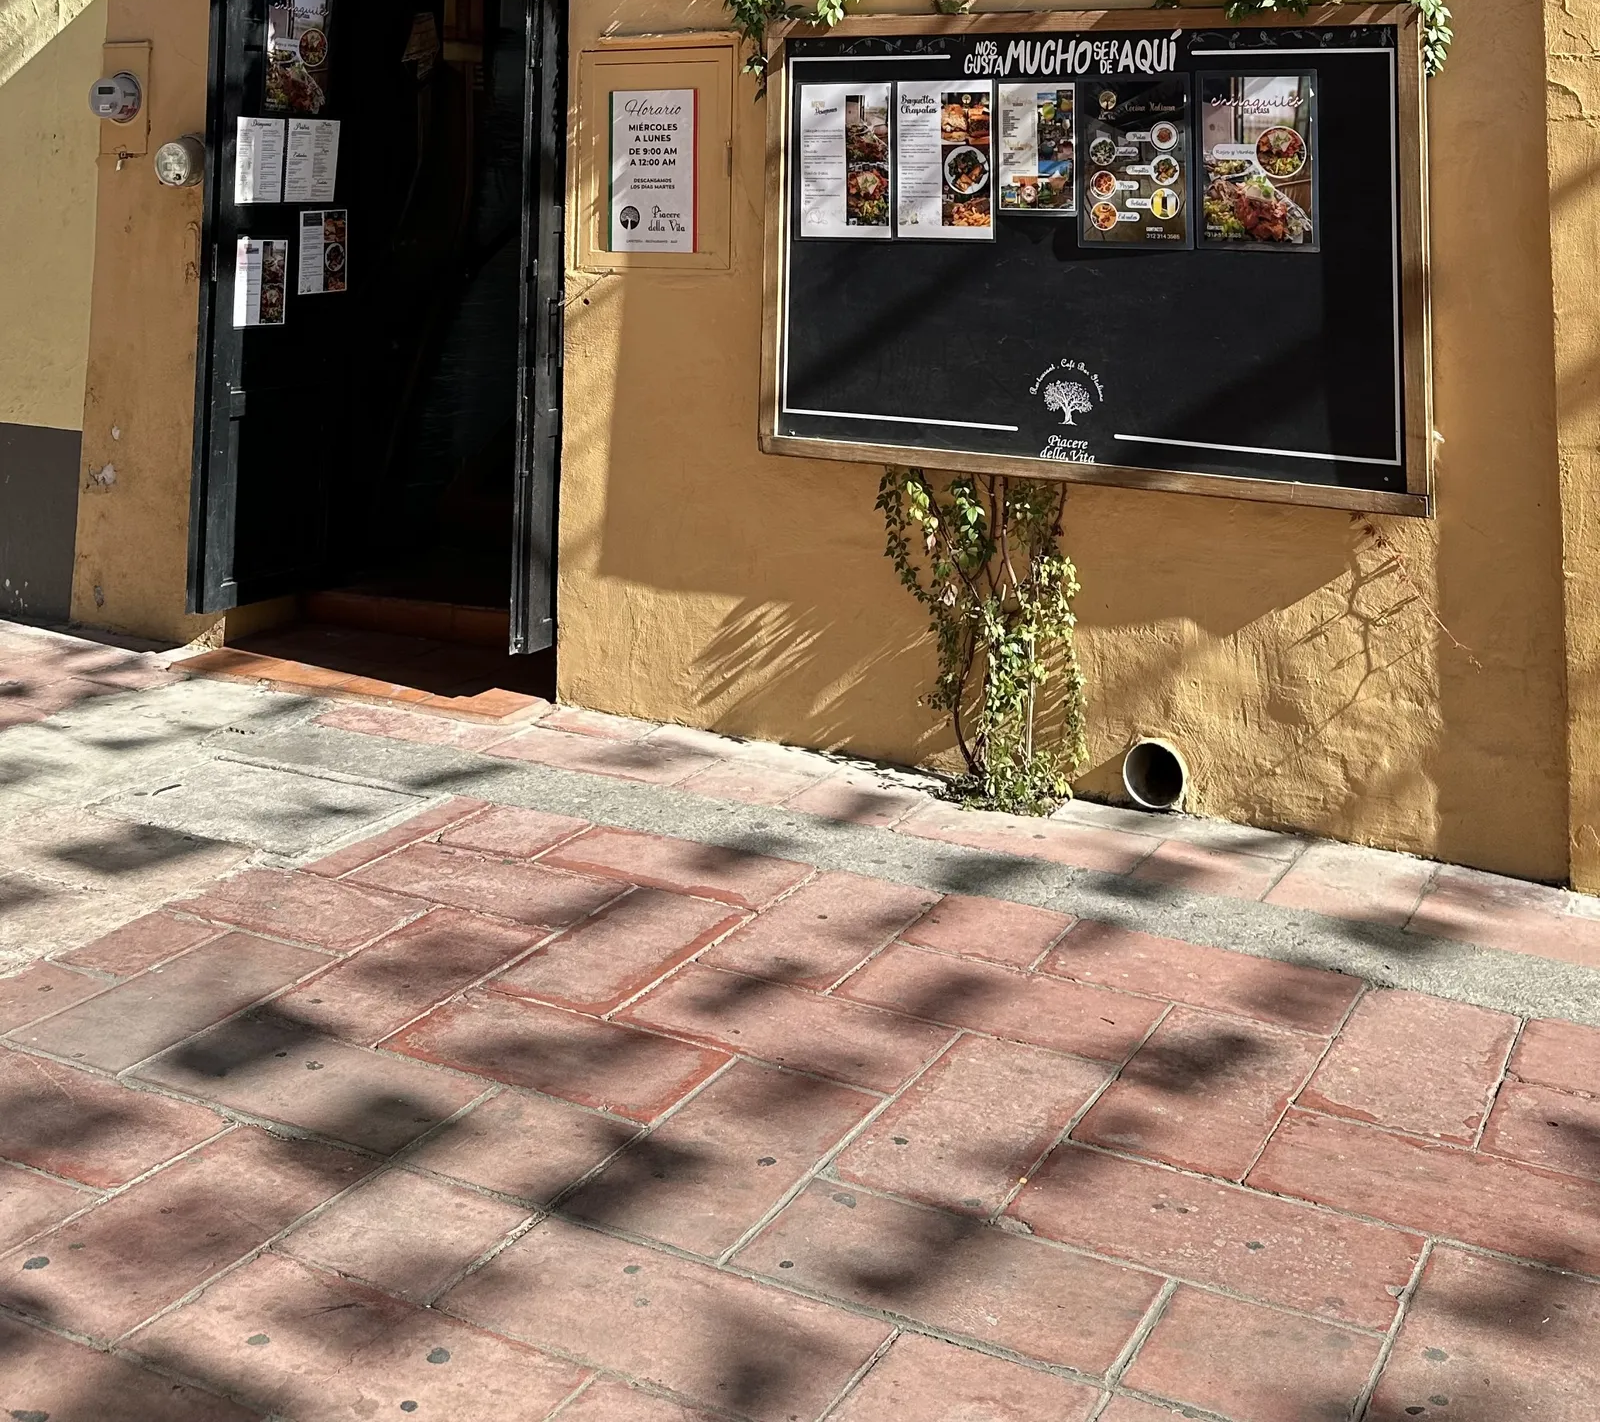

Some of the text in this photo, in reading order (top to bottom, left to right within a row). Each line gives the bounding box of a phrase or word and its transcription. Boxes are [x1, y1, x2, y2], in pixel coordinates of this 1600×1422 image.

[964, 28, 1182, 76] NOS GUSTA MUCHO SER DE AQUÍ
[624, 98, 682, 116] Horario
[628, 122, 678, 131] MIÉRCOLES
[643, 134, 671, 142] LUNES
[652, 205, 681, 218] Piacere
[648, 219, 685, 231] della Vita
[1048, 434, 1088, 449] Piacere
[1040, 445, 1095, 463] della Vita
